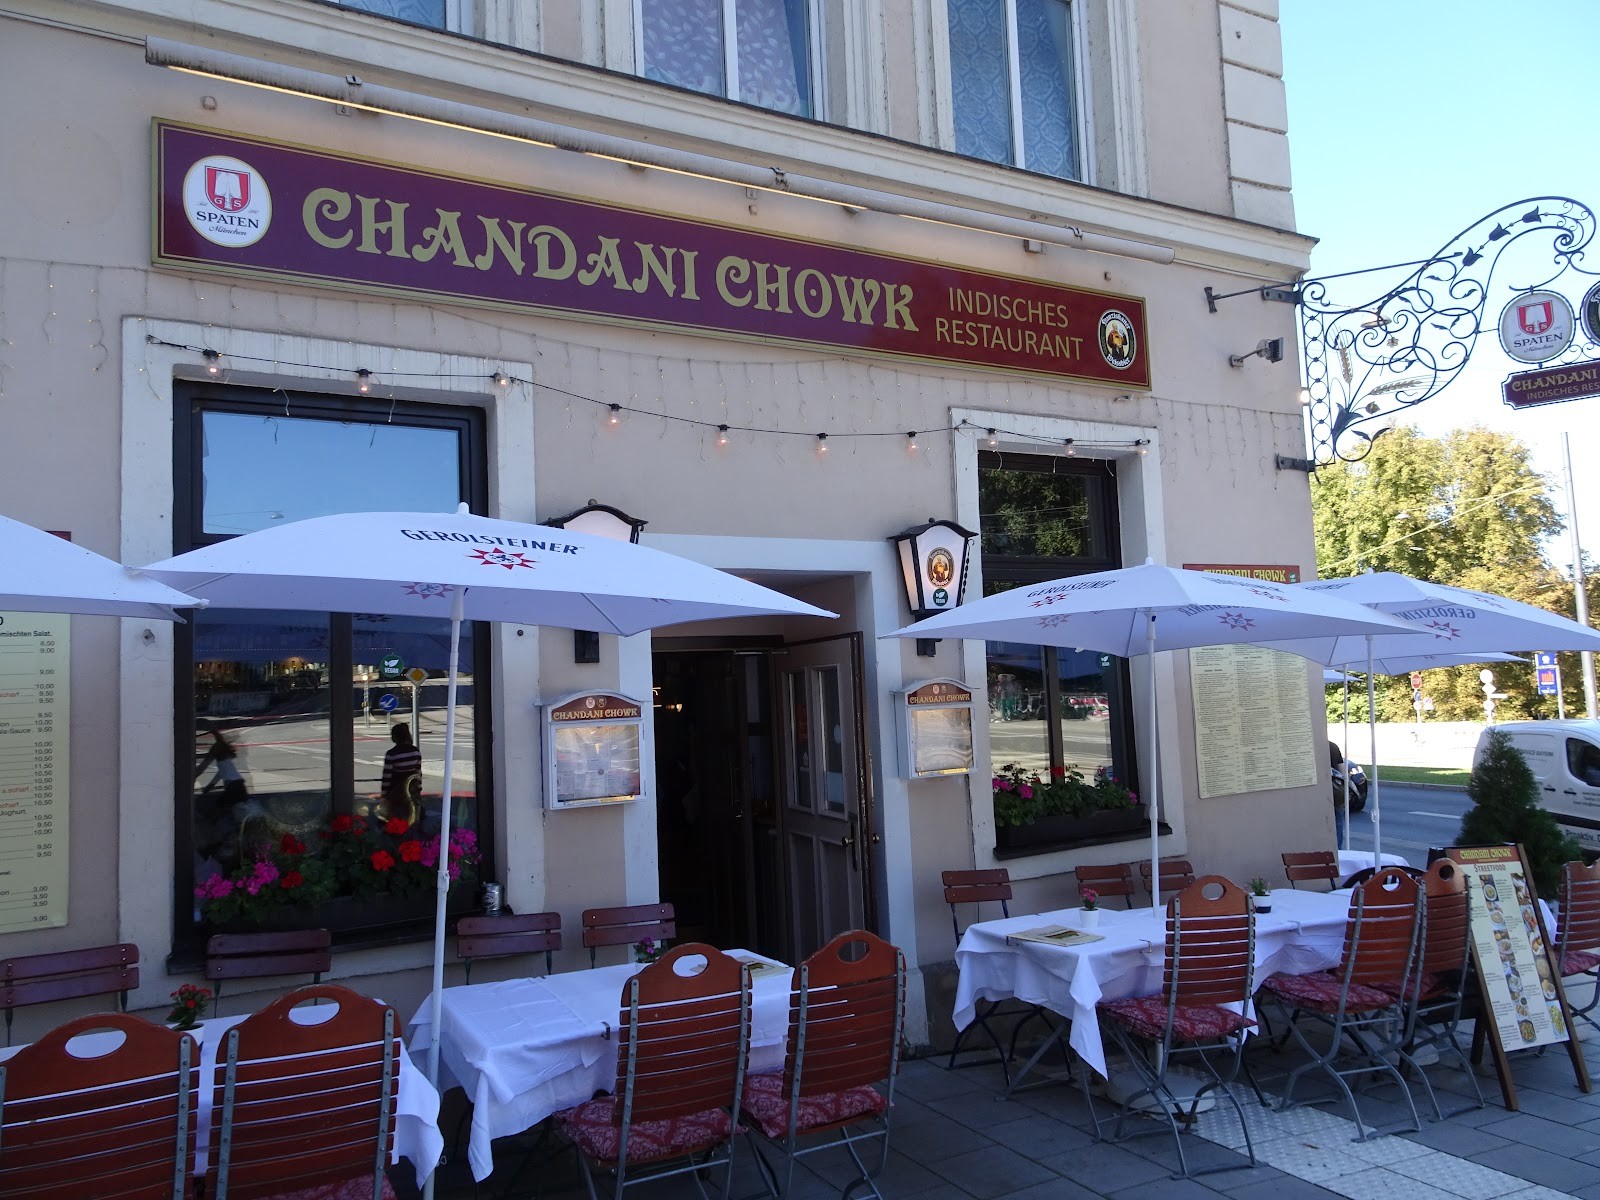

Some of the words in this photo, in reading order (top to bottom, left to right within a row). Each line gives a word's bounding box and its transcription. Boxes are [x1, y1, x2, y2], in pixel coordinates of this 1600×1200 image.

[196, 210, 260, 229] SPATEN
[208, 225, 247, 236] München
[302, 187, 700, 301] CHANDANI
[716, 255, 920, 332] CHOWK
[948, 286, 1069, 328] INDISCHES
[935, 318, 1083, 361] RESTAURANT
[1513, 333, 1563, 348] SPATEN
[1511, 368, 1598, 392] CHANDANI
[1527, 384, 1579, 400] INDISCHES
[1581, 381, 1600, 392] RES
[400, 529, 579, 555] GEROLSTEINER
[1253, 569, 1286, 582] CHOWK
[909, 695, 945, 704] CHANDANI
[946, 693, 970, 702] CHOWK
[553, 709, 603, 720] CHANDANI
[604, 708, 637, 718] CHOWK
